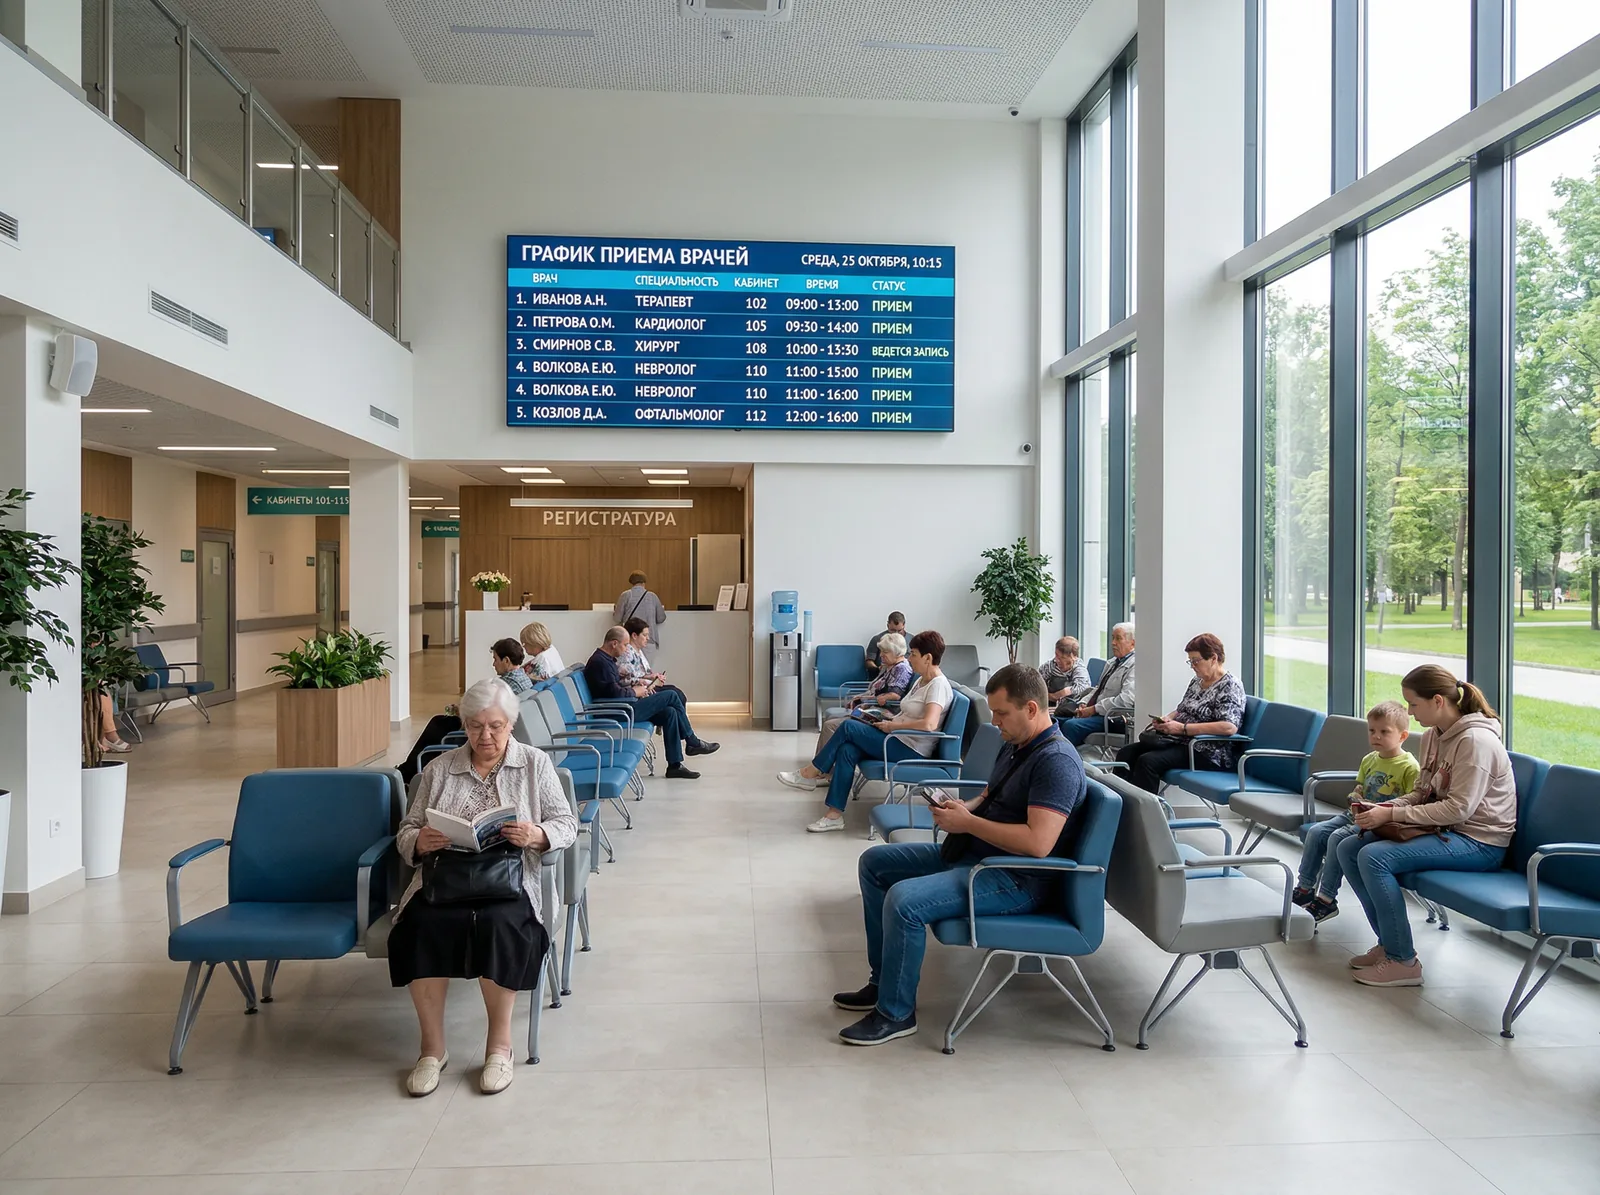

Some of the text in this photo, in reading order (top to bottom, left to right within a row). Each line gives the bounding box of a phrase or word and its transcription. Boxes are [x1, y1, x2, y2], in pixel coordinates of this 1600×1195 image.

[522, 245, 749, 266] ГРАФИК ПРИЕМА ВРАЧЕЙ
[801, 254, 942, 269] СРЕДА, 25 ОКТЯБРЯ, 10:15
[532, 273, 906, 292] ВРАЧ СПЕЦИАЛЬНОСТЬ КАБИНЕТ ВРЕМЯ СТАТУС
[516, 293, 527, 305] 1.
[532, 293, 582, 306] ИВАНОВ
[583, 295, 608, 306] А.Н.
[634, 296, 694, 308] ТЕРАПЕВТ
[745, 298, 767, 310] 102
[785, 298, 818, 311] 09:00
[827, 300, 859, 312] 13:00
[872, 300, 913, 313] ПРИЕМ
[516, 316, 527, 328] 2.
[533, 316, 588, 329] ПЕТРОВА
[589, 317, 615, 329] О.М.
[635, 318, 707, 332] КАРДИОЛОГ
[745, 320, 767, 332] 105
[785, 321, 818, 333] 09:30
[827, 322, 859, 334] 14:00
[872, 323, 913, 335] ПРИЕМ
[516, 339, 527, 350] 3.
[532, 339, 592, 351] СМИРНОВ
[594, 340, 616, 352] С.В.
[634, 340, 681, 353] ХИРУРГ
[745, 343, 767, 355] 108
[785, 344, 818, 355] 10:00
[827, 344, 859, 356] 13:30
[871, 347, 912, 358] ВЕДЕТСЯ
[913, 347, 950, 358] ЗАПИСЬ
[515, 361, 527, 373] 4.
[532, 361, 590, 374] ВОЛКОВА
[591, 362, 617, 374] Е.Ю.
[635, 363, 697, 376] НЕВРОЛОГ
[745, 365, 768, 377] 110
[785, 366, 818, 378] 11:00
[826, 367, 859, 378] 15:00
[872, 367, 912, 379] ПРИЕМ
[515, 384, 527, 396] 4.
[533, 384, 590, 397] ВОЛКОВА
[591, 385, 617, 397] Е.Ю.
[635, 386, 697, 398] НЕВРОЛОГ
[745, 388, 768, 400] 110
[785, 389, 818, 400] 11:00
[826, 389, 859, 401] 16:00
[871, 390, 912, 402] ПРИЕМ
[516, 407, 527, 419] 5.
[532, 407, 581, 419] КОЗЛОВ
[582, 408, 607, 421] Д.А.
[634, 408, 725, 421] ОФТАЛЬМОЛОГ
[745, 410, 767, 422] 112
[785, 411, 818, 423] 12:00
[826, 411, 859, 423] 16:00
[871, 412, 912, 424] ПРИЕМ
[266, 495, 313, 505] КАБИНЕТЫ
[543, 511, 676, 526] РЕГИСТРАТУРА
